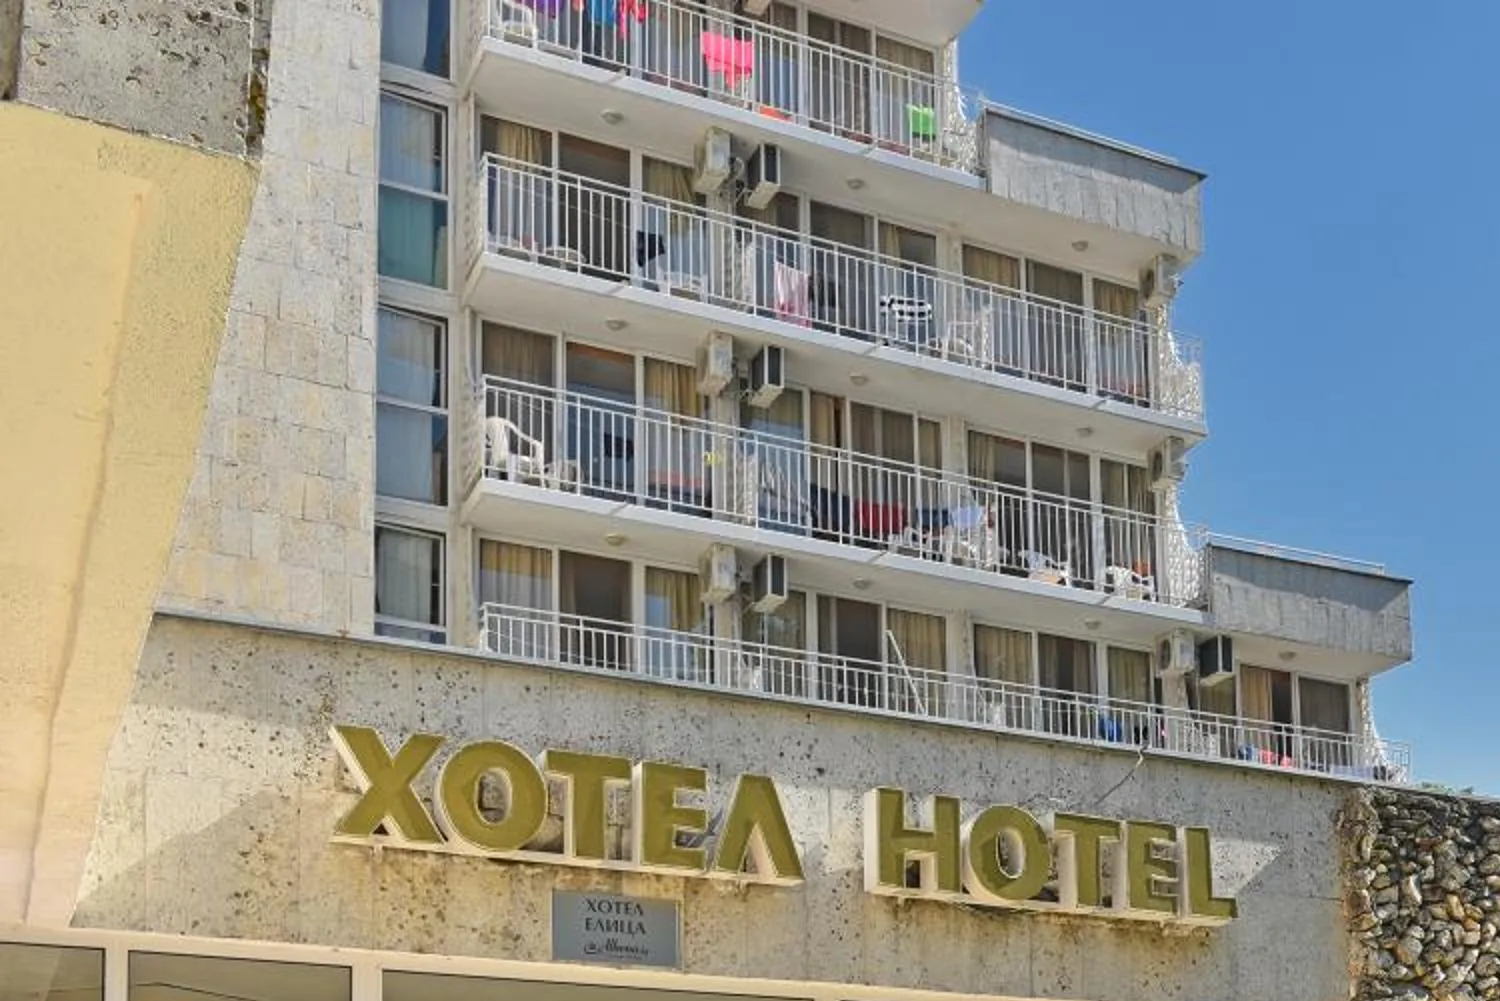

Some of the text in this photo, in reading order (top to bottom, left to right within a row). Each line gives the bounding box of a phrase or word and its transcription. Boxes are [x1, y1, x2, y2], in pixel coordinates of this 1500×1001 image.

[331, 724, 803, 882] ХОТЕЛ
[864, 786, 1238, 921] HOTEL
[583, 898, 645, 916] ХОТЕЛ
[585, 917, 647, 936] ЕЛИЦА
